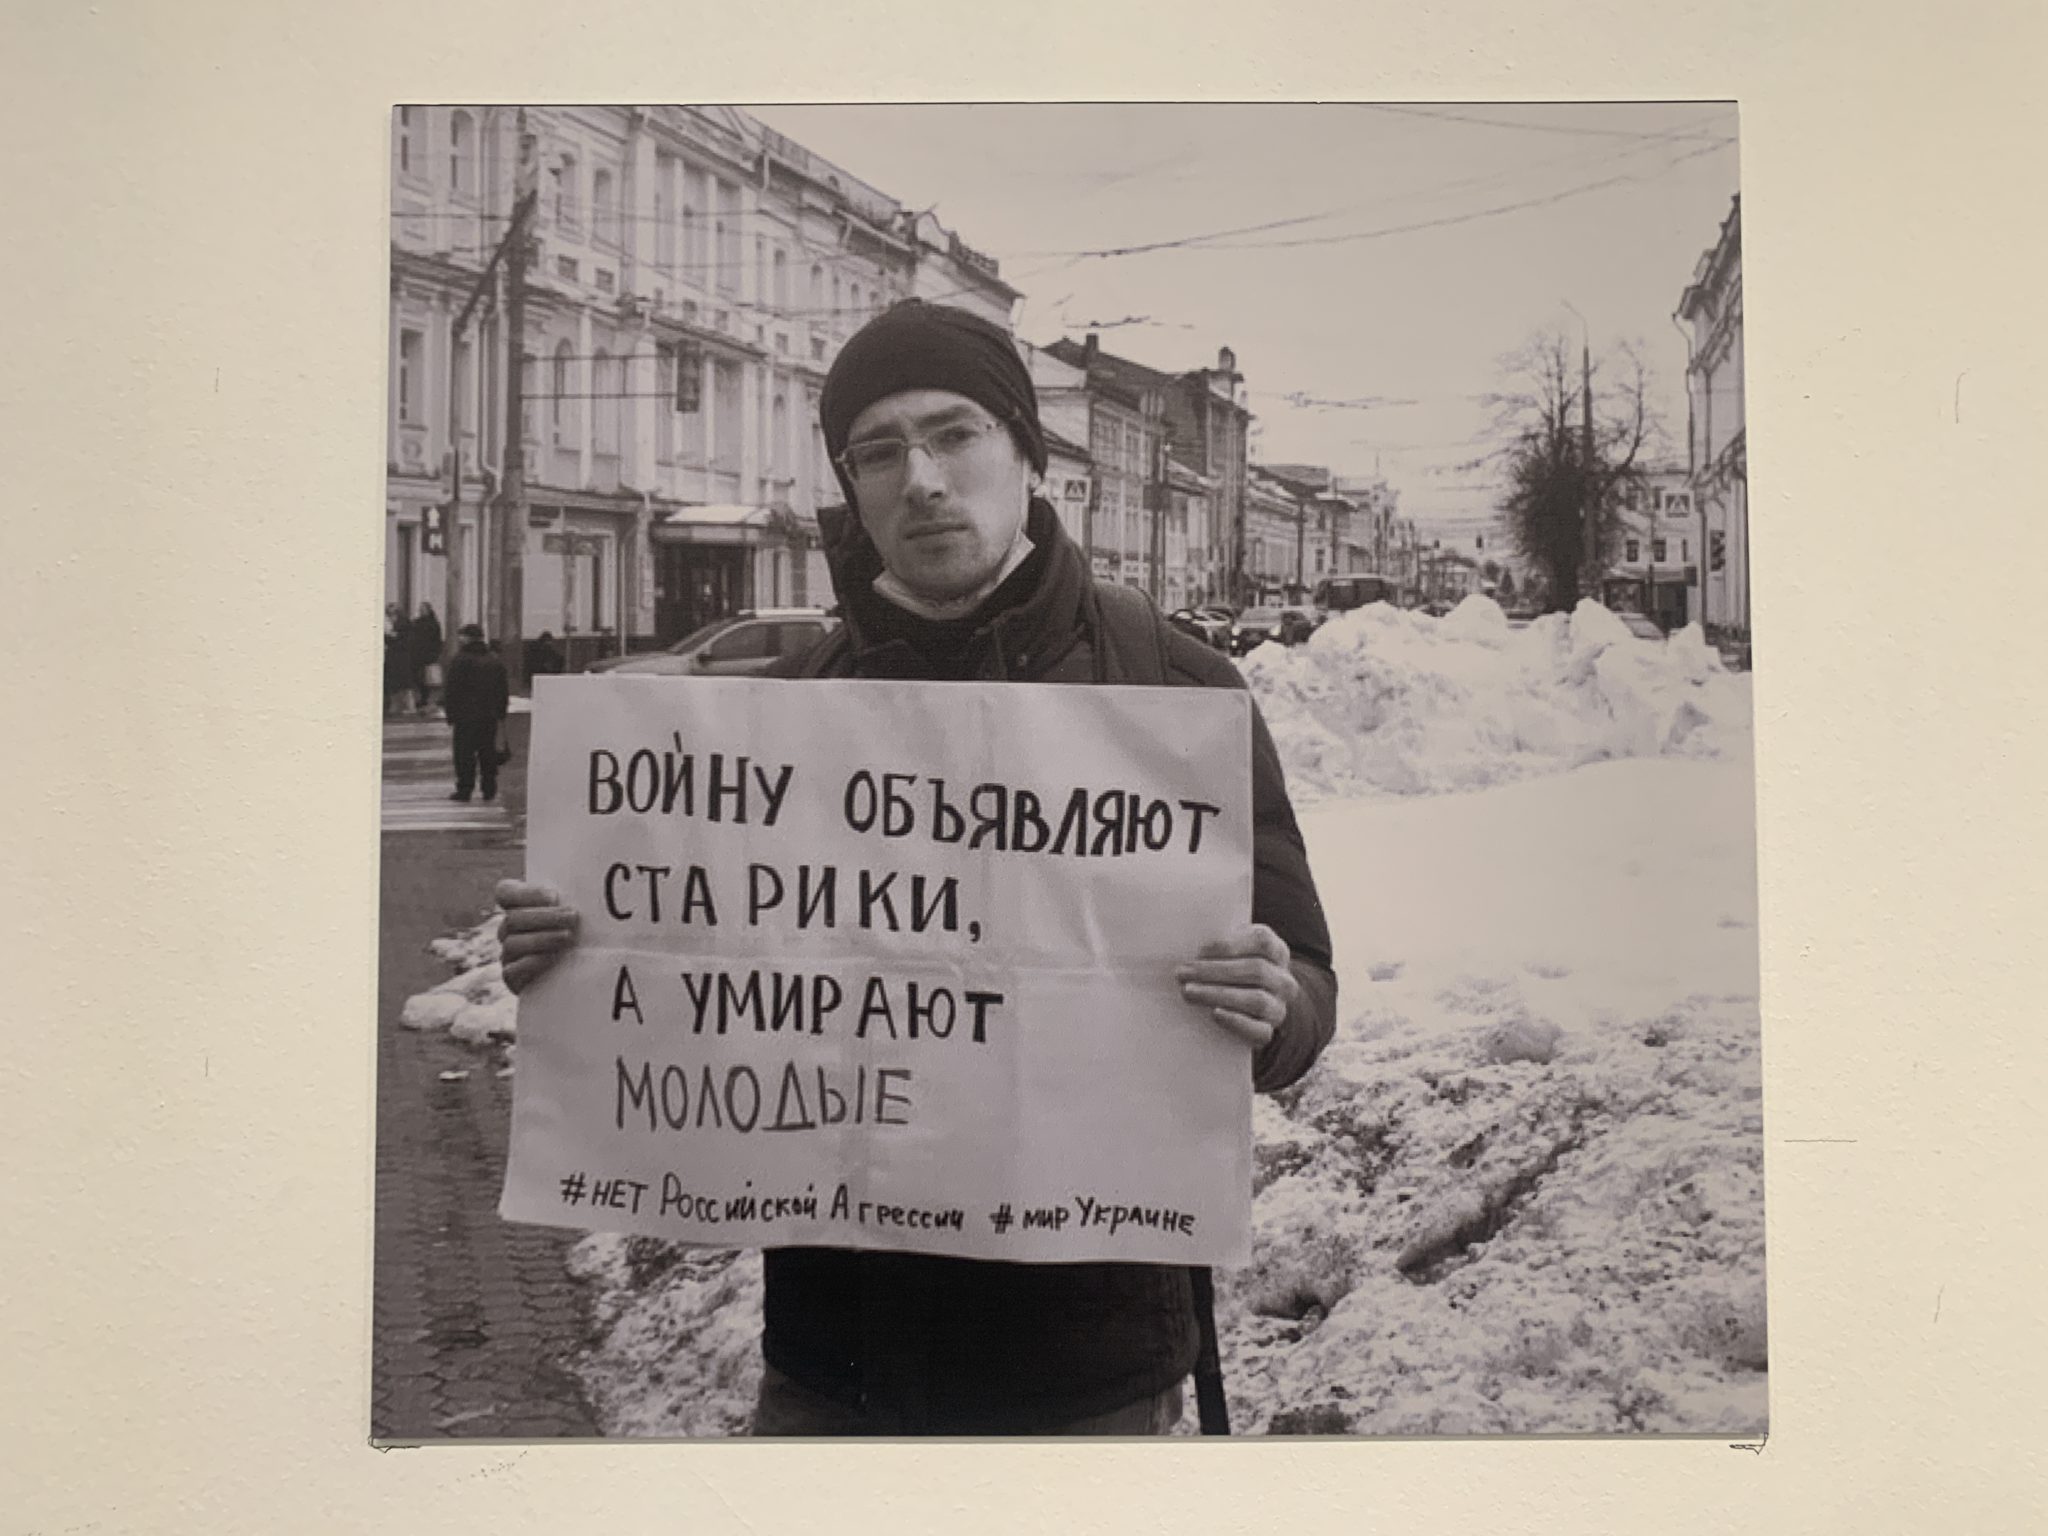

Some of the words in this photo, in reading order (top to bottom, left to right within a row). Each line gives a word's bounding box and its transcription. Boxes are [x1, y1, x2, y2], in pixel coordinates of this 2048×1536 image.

[589, 731, 793, 826] ВОЙНУ
[844, 769, 1221, 858] ОБЪЯВЛЯЮТ
[611, 965, 643, 1025] А
[681, 970, 1004, 1043] УМИРАЮТ
[616, 1056, 912, 1132] МОЛОДЫЕ
